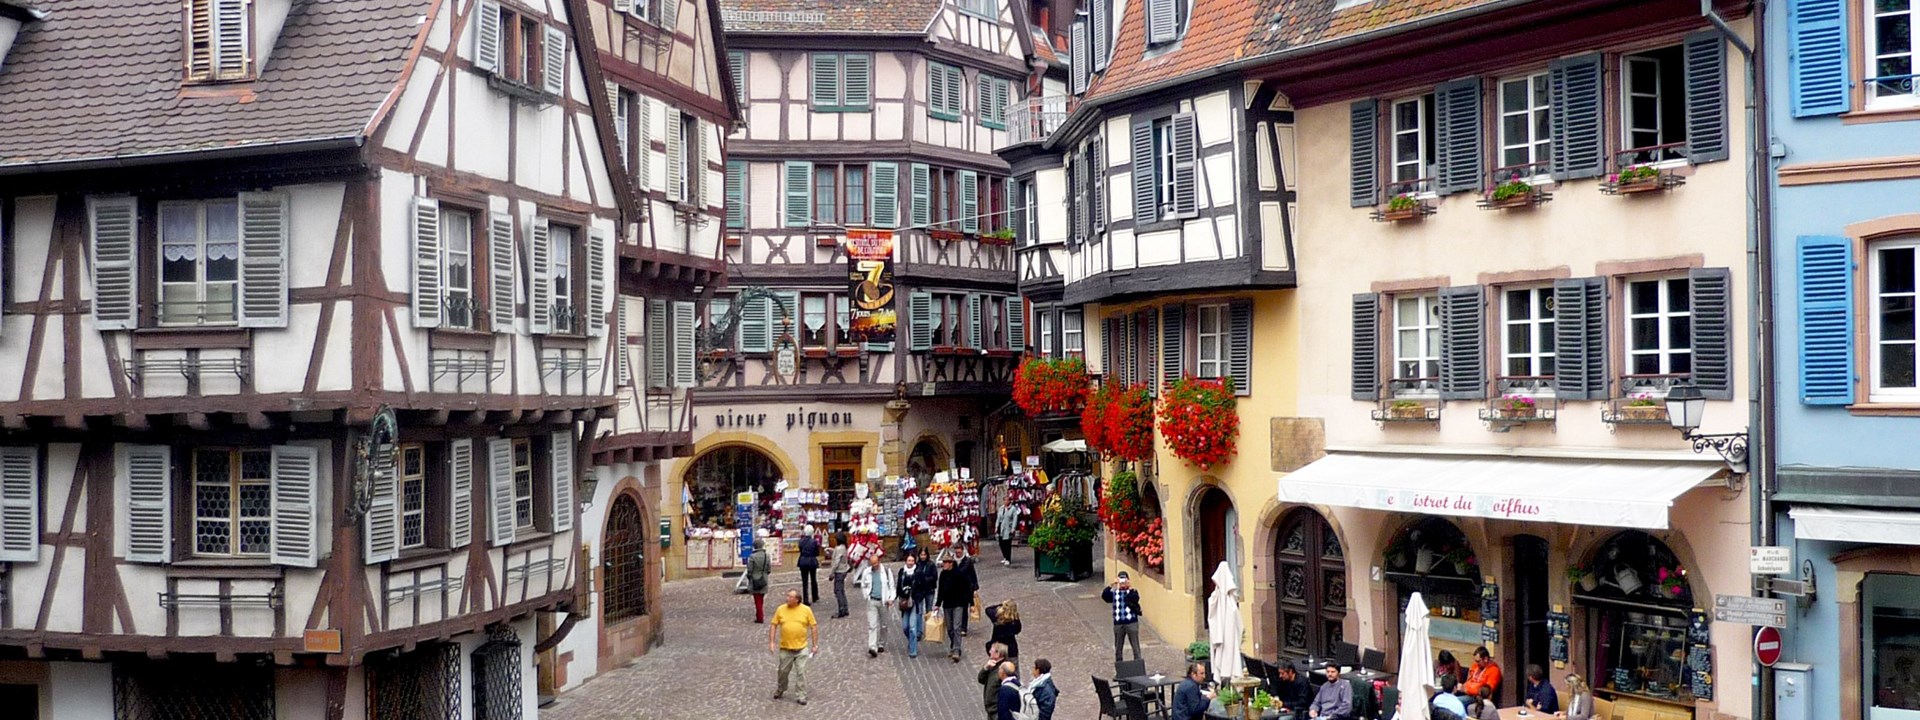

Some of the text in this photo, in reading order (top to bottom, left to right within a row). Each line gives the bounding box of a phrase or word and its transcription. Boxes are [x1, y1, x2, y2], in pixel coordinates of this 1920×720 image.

[716, 409, 767, 427] vieux
[787, 407, 853, 431] pignon
[1453, 495, 1473, 510] du
